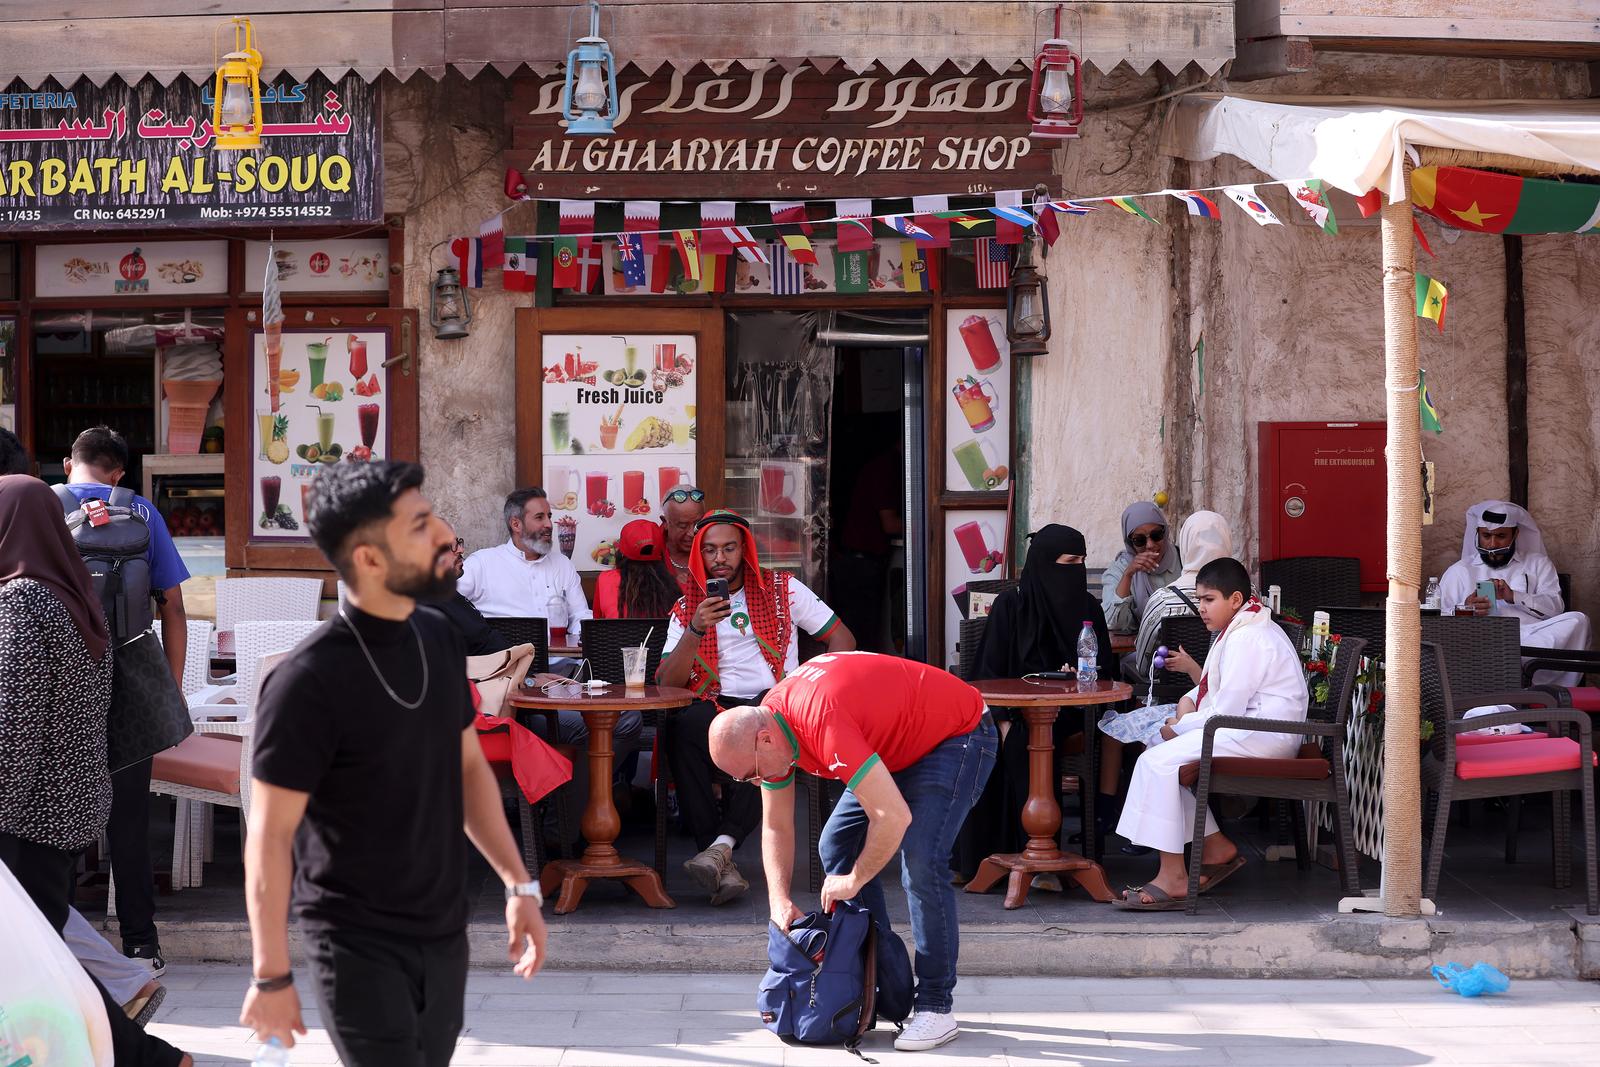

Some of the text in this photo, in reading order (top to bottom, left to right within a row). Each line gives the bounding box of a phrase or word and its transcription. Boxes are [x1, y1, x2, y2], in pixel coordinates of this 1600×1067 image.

[137, 89, 351, 150] شربت
[792, 136, 925, 178] COFFEE
[931, 136, 1031, 171] SHOP
[161, 153, 351, 194] AL-SOUQ
[7, 210, 41, 221] 1/435
[74, 209, 90, 220] CR
[93, 209, 114, 220] No:
[116, 208, 166, 220] 64529/1
[200, 207, 232, 218] Mob:
[234, 206, 267, 217] +974
[269, 205, 332, 217] 55514552
[577, 387, 664, 404] Fresh Juice
[1314, 458, 1375, 466] FIRE EXTINGUISHER
